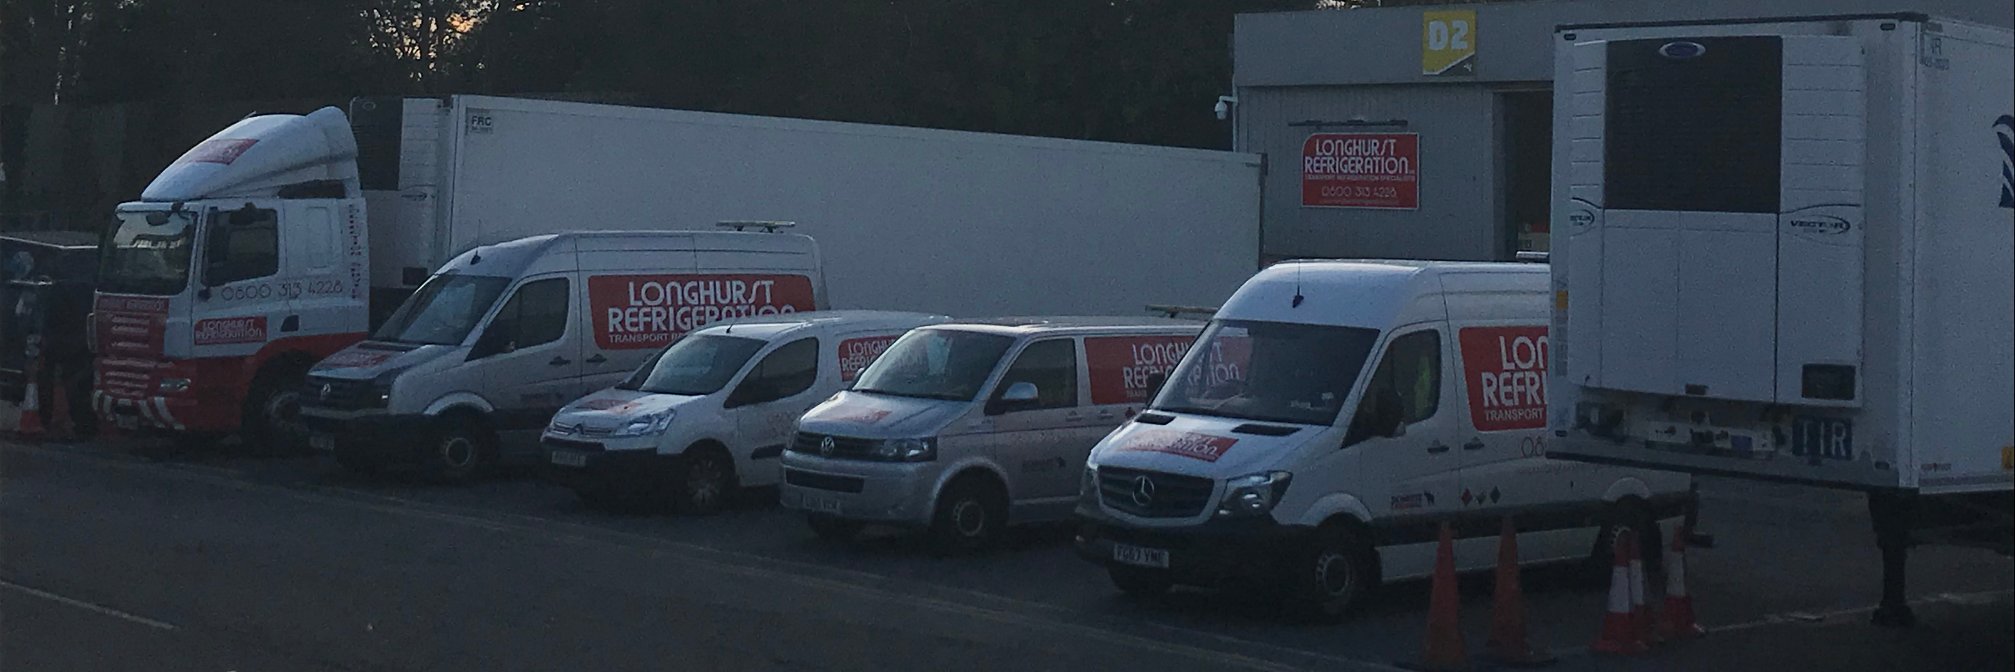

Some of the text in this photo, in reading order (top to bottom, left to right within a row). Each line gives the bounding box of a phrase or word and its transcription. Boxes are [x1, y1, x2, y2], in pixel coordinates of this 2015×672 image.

[1429, 20, 1468, 50] D2
[1316, 139, 1396, 156] LONGHURST
[1304, 156, 1408, 174] REFRIGERATION
[628, 280, 774, 306] LONGHURST
[609, 331, 669, 343] TRANSPORT
[1484, 408, 1544, 421] TRANSPORT
[1799, 419, 1846, 456] TIR
